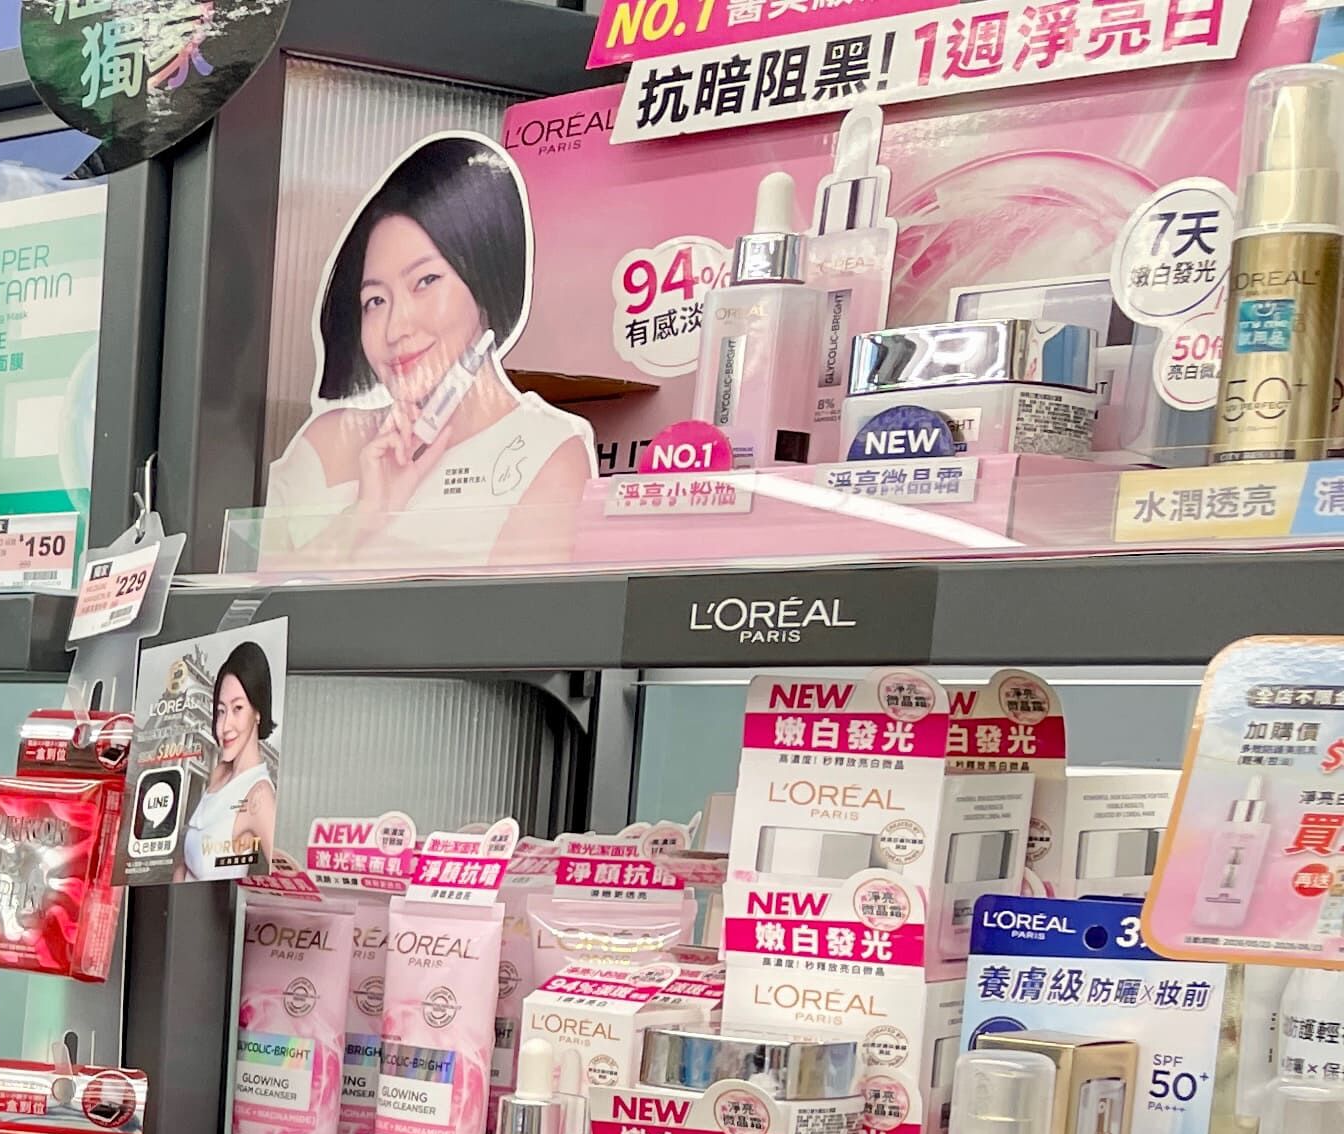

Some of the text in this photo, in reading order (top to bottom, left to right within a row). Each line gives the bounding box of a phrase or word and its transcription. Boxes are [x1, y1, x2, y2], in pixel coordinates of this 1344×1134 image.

[636, 32, 896, 129] 抗暗阻黑!
[538, 140, 582, 156] PARIS
[1148, 209, 1220, 257] 7天
[825, 291, 844, 387] GLYCOLIC-BRIGHT
[720, 338, 738, 425] GLYCOLIC-BRIGHT
[864, 428, 940, 455] NEW
[652, 444, 711, 468] NO.1
[1134, 485, 1276, 521] 水潤透亮
[690, 597, 856, 630] L'ORÉAL
[740, 630, 801, 643] PARIS
[768, 683, 856, 710] NEW
[775, 716, 916, 754] 嫩白發光
[147, 794, 170, 811] LINE
[769, 780, 906, 811] L'ORÉAL
[810, 808, 860, 822] PARIS
[314, 823, 374, 845] NEW
[419, 858, 500, 890] 淨顏抗暗
[566, 862, 679, 887] 淨顏抗暗
[747, 892, 832, 916] NEW
[983, 909, 1077, 935] L'ORÉAL
[1011, 929, 1046, 941] PARIS
[245, 922, 336, 952] L'ORÉAL
[754, 925, 894, 961] 嫩白發光
[270, 949, 304, 962] PARIS
[408, 956, 443, 969] PARIS
[977, 964, 1084, 1003] 養膚級
[754, 983, 888, 1017] L'ORÉAL
[532, 1013, 621, 1042] L'ORÉAL
[795, 1011, 844, 1026] PARIS
[559, 1036, 591, 1048] PARIS
[1152, 1054, 1184, 1068] SPF
[241, 1073, 290, 1090] GLOWING
[259, 1086, 298, 1102] CLEANSER
[382, 1085, 428, 1104] GLOWING
[612, 1095, 690, 1125] NEW
